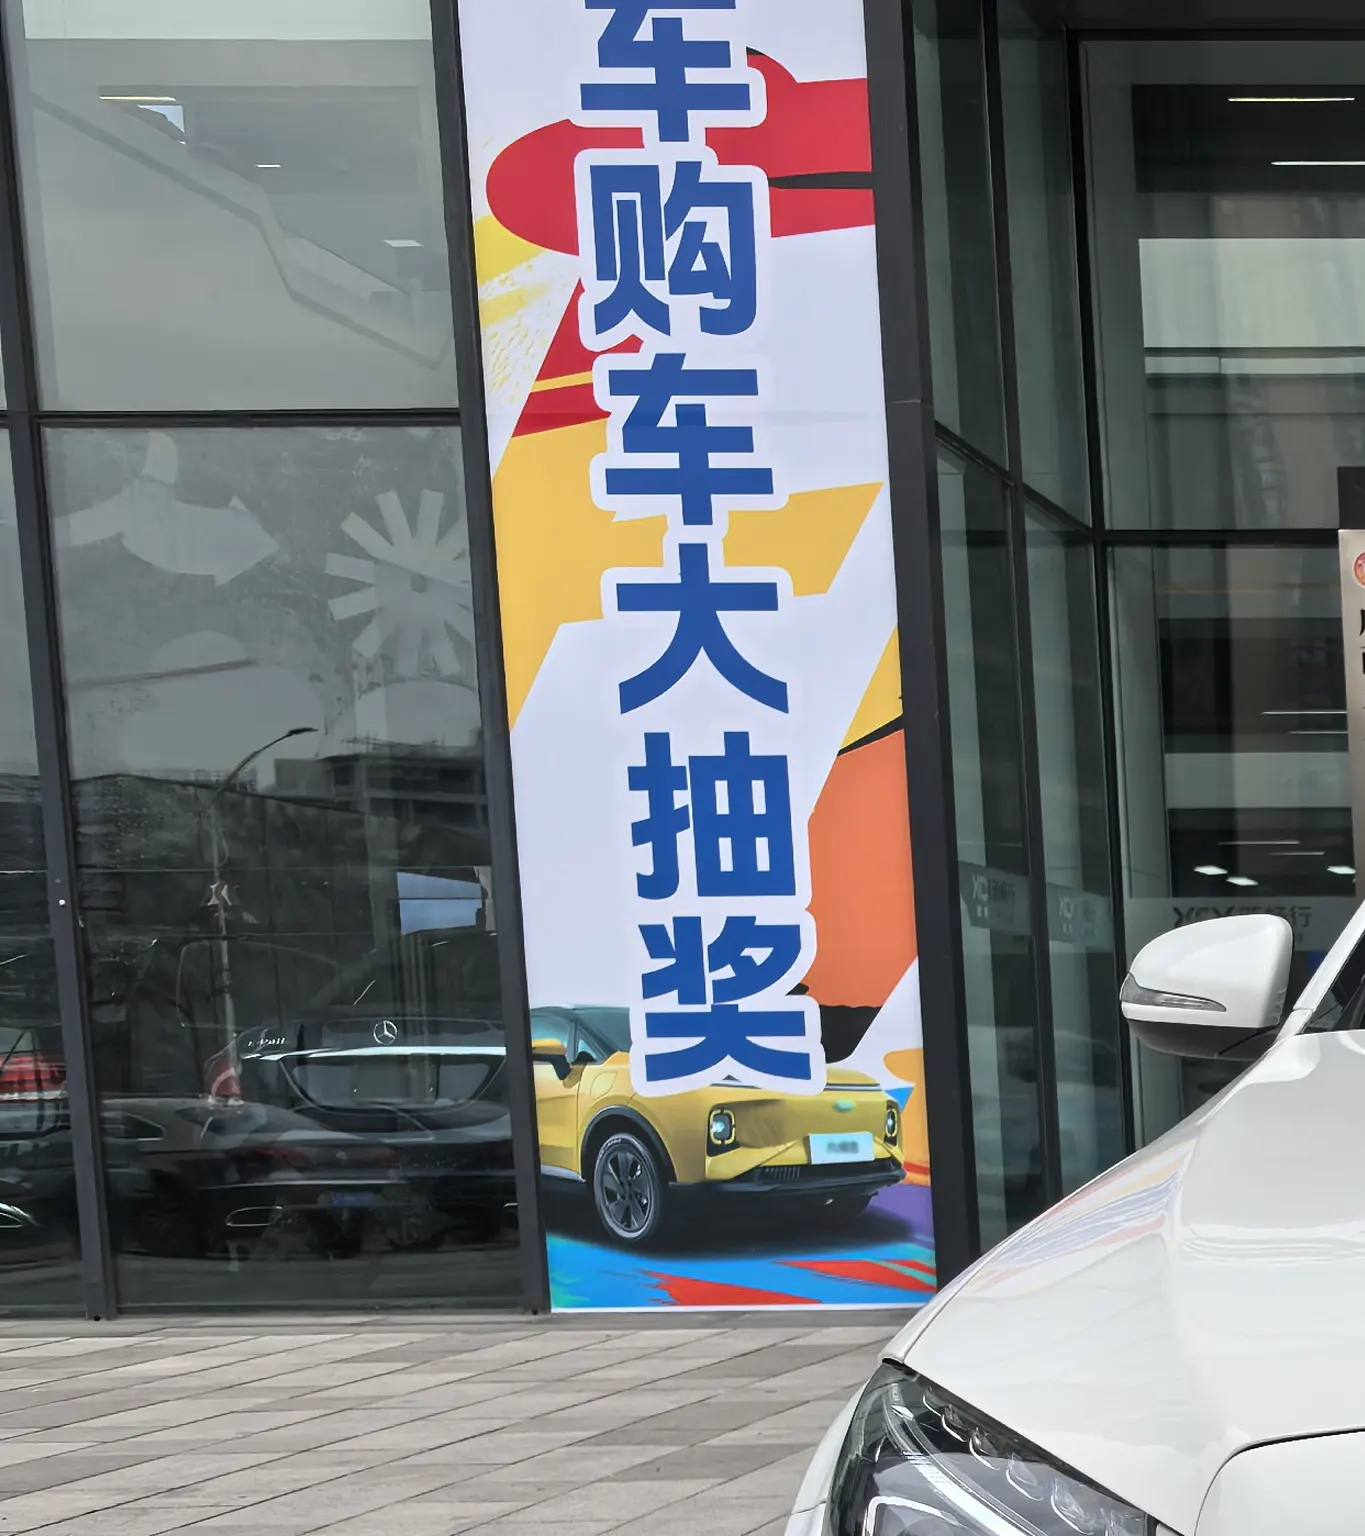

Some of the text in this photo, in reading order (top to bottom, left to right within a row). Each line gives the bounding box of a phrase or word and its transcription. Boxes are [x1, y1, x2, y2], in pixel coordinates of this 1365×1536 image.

[581, 0, 811, 1081] 车购车大抽奖
